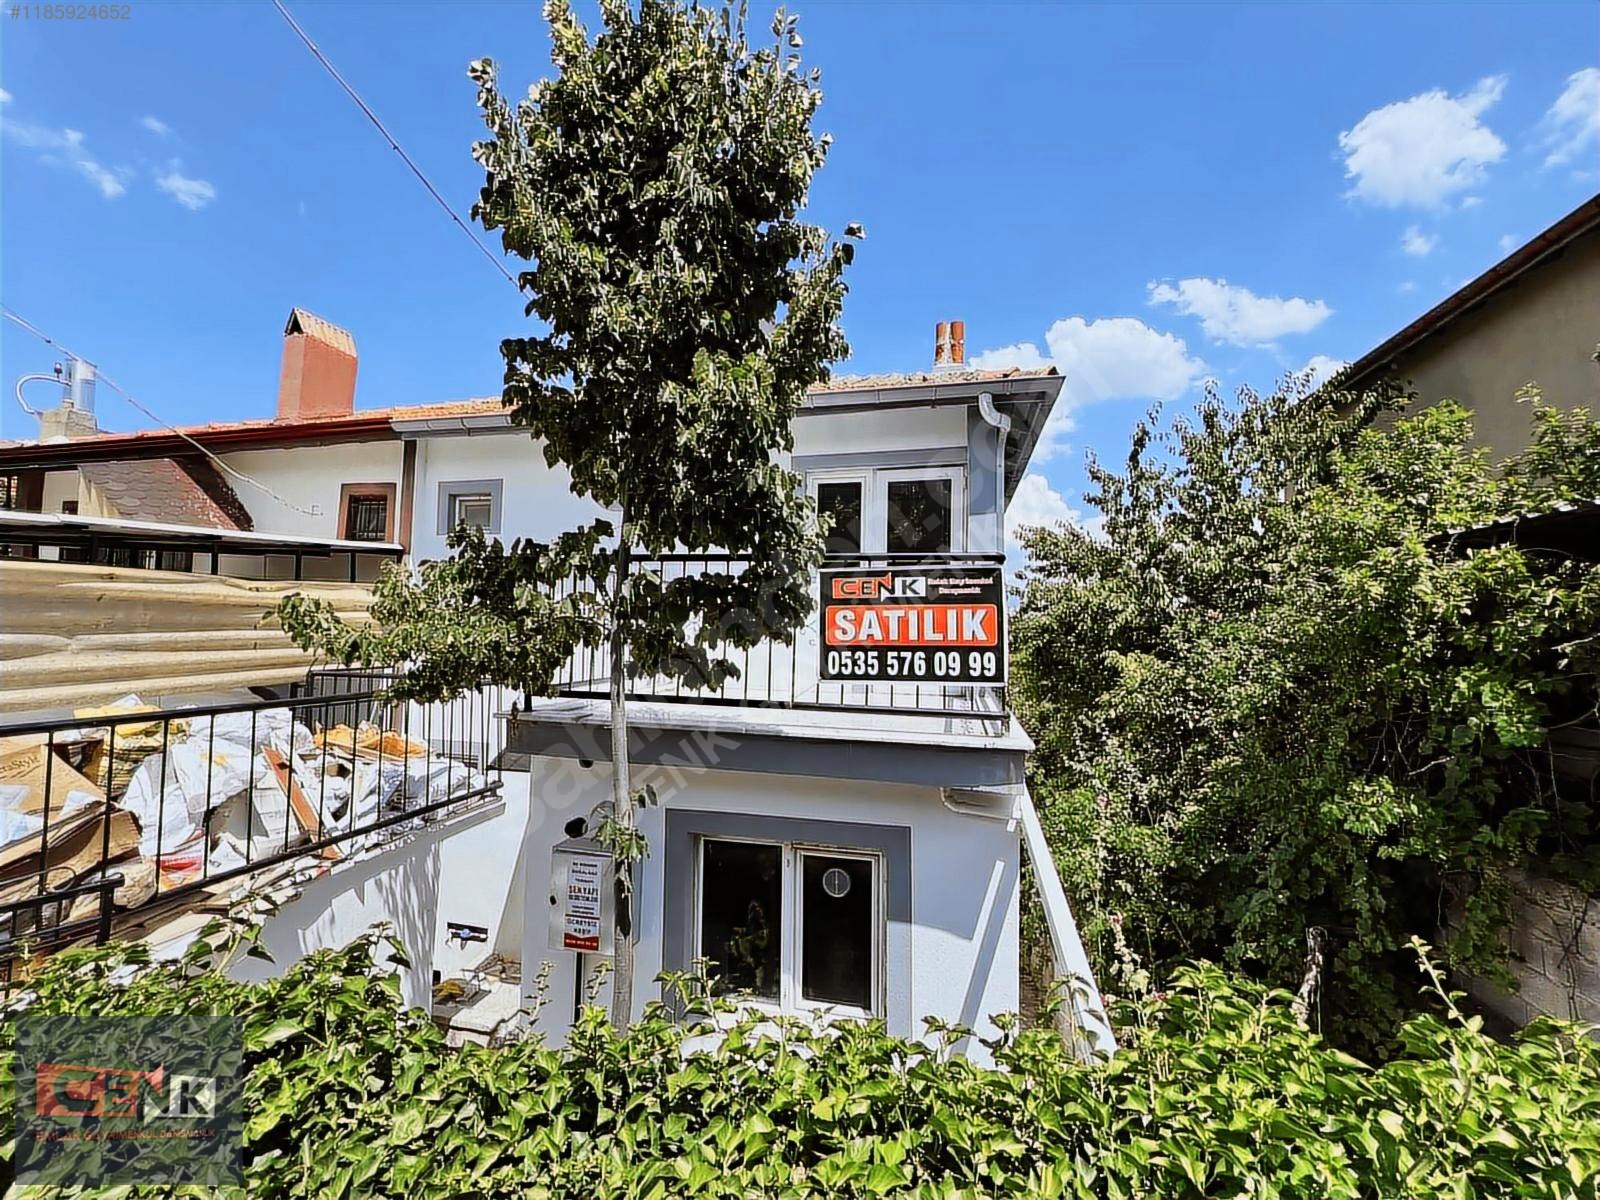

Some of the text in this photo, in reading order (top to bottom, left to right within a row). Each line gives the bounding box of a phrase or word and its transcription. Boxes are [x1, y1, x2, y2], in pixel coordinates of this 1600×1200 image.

[838, 573, 923, 601] CENK
[834, 608, 988, 642] SATILIK
[827, 650, 996, 677] 0535 576 09 99
